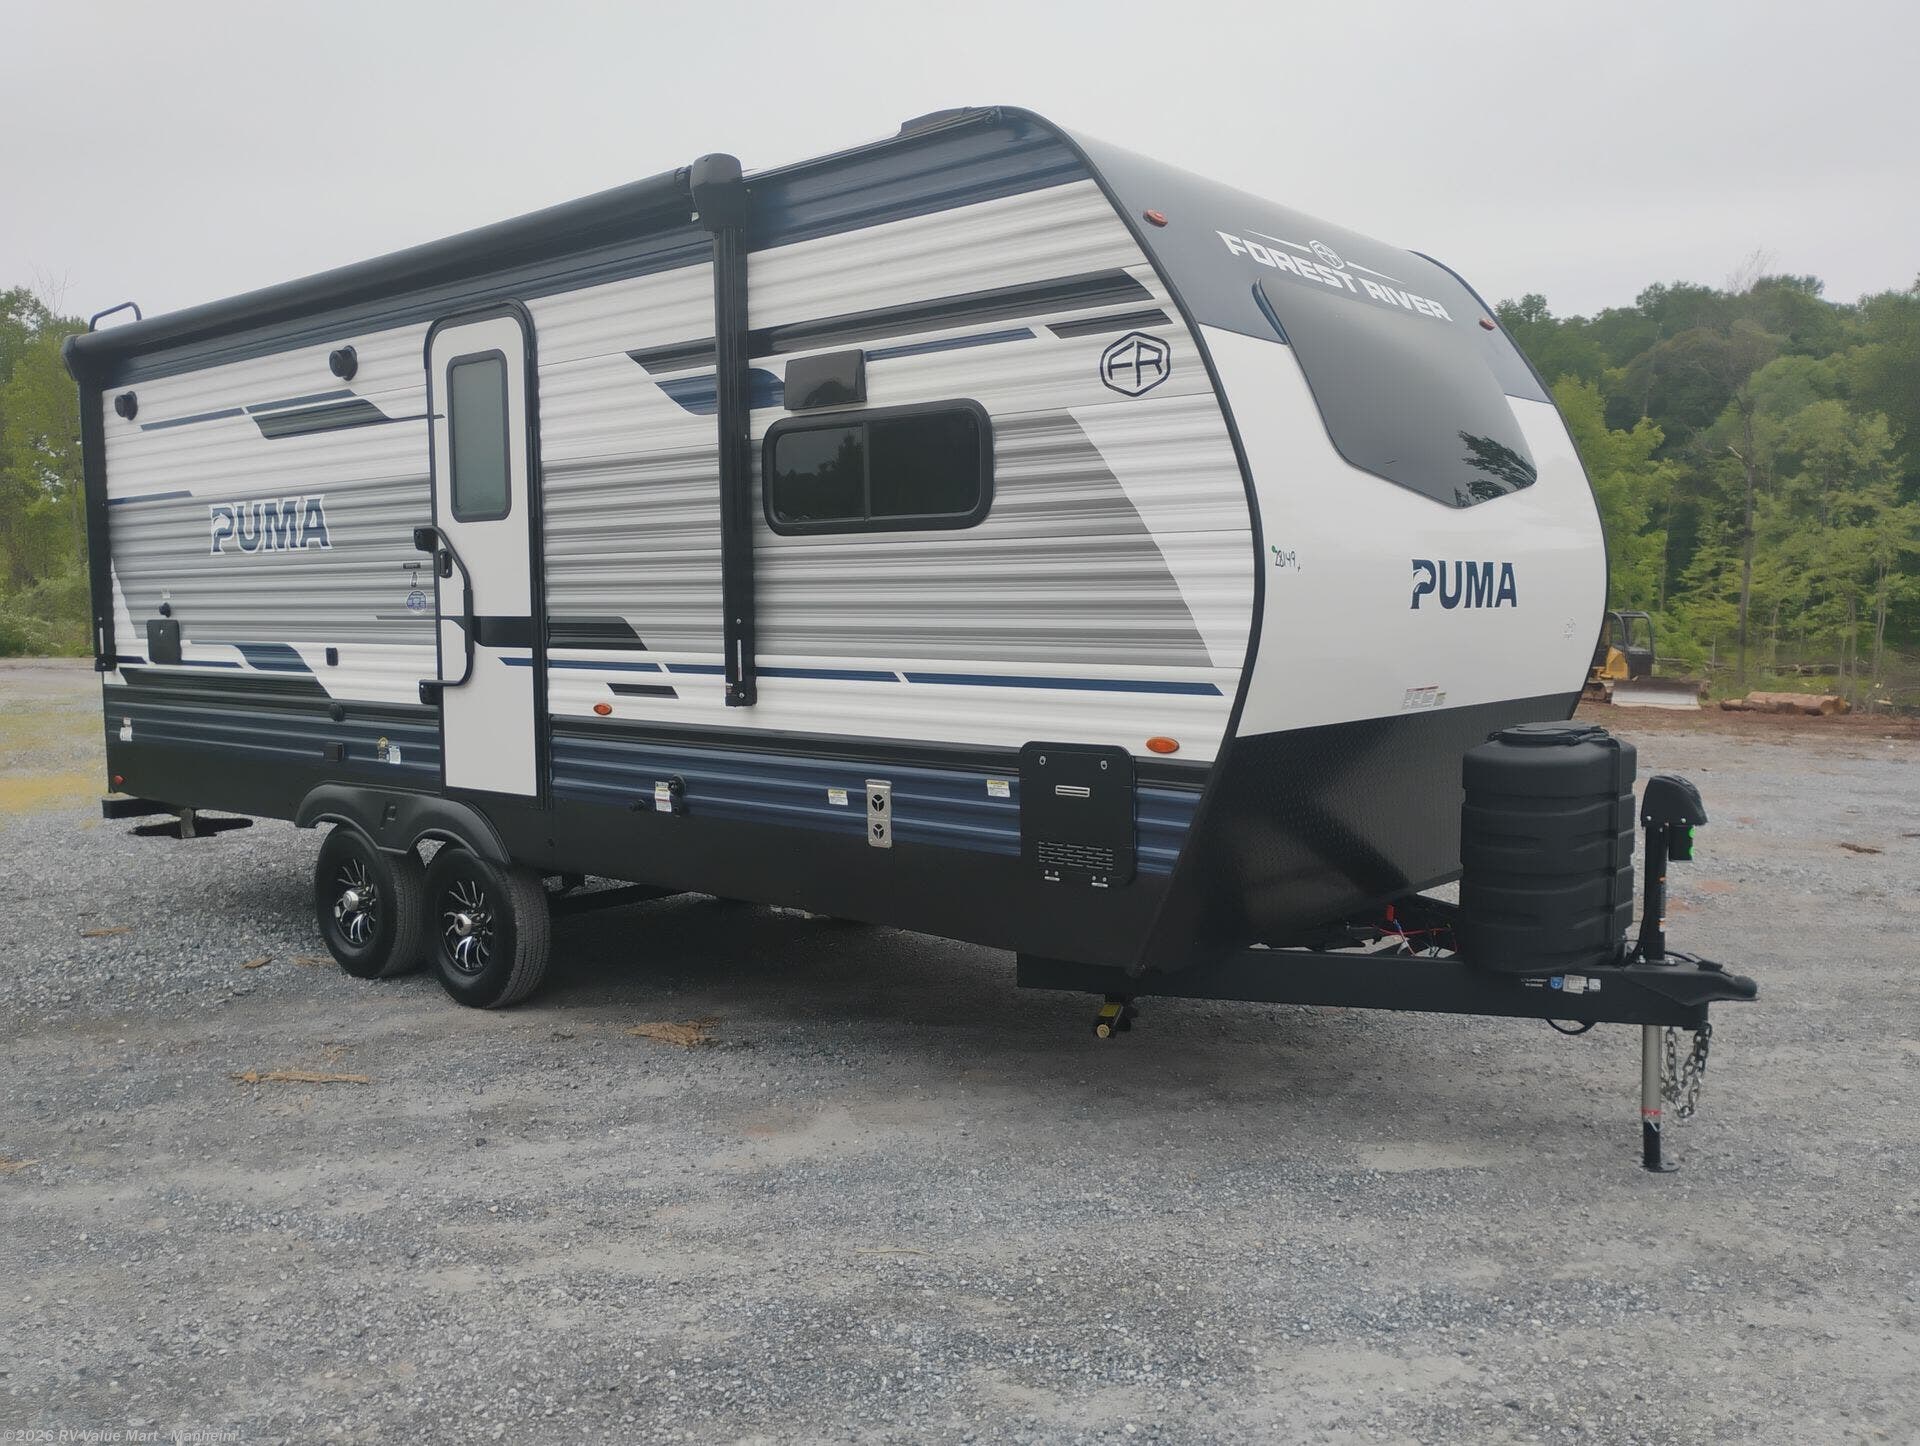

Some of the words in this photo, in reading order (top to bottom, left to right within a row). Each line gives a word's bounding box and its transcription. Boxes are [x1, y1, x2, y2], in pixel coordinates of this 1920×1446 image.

[1216, 231, 1357, 293] FOREST
[1358, 277, 1453, 322] RIVER
[210, 494, 332, 555] PUMA
[1410, 559, 1517, 609] PUMA
